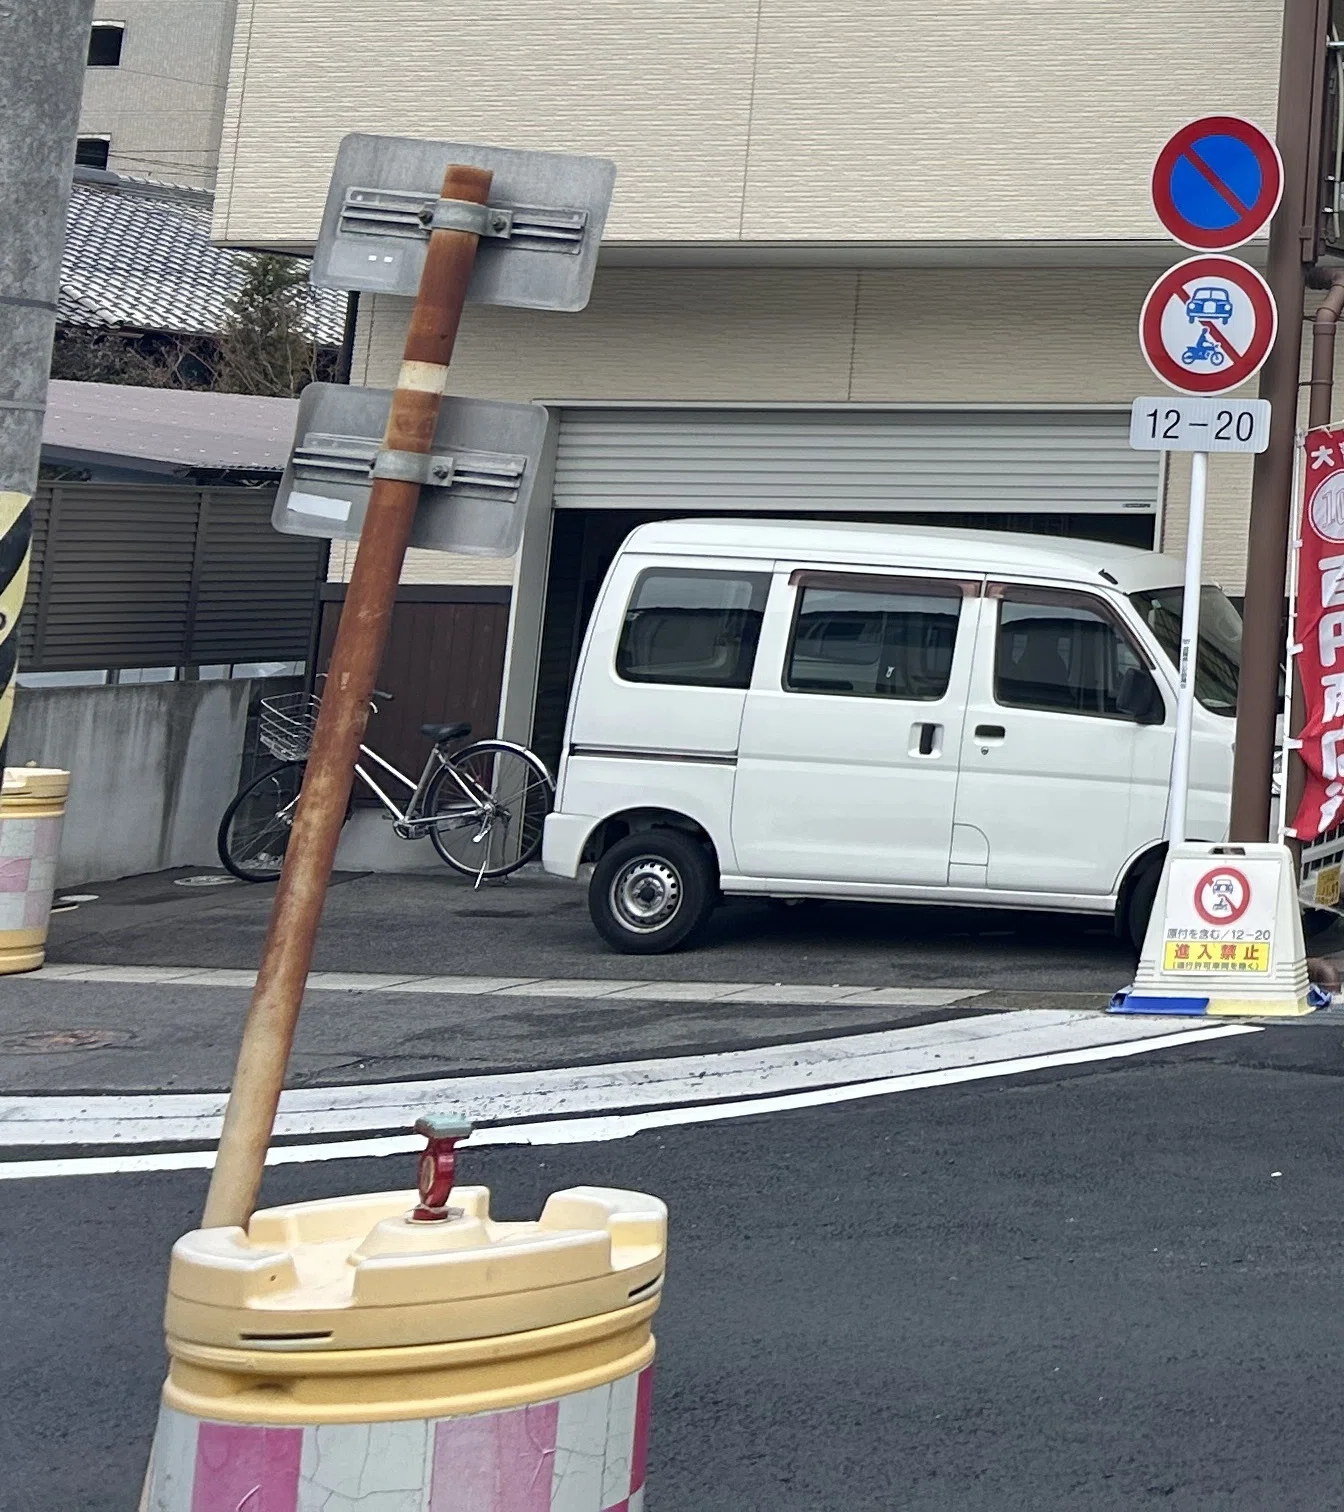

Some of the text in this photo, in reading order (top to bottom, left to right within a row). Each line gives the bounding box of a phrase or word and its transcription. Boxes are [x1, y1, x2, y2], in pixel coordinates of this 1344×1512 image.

[1146, 408, 1254, 442] 12-20
[1174, 942, 1260, 961] 進入禁止
